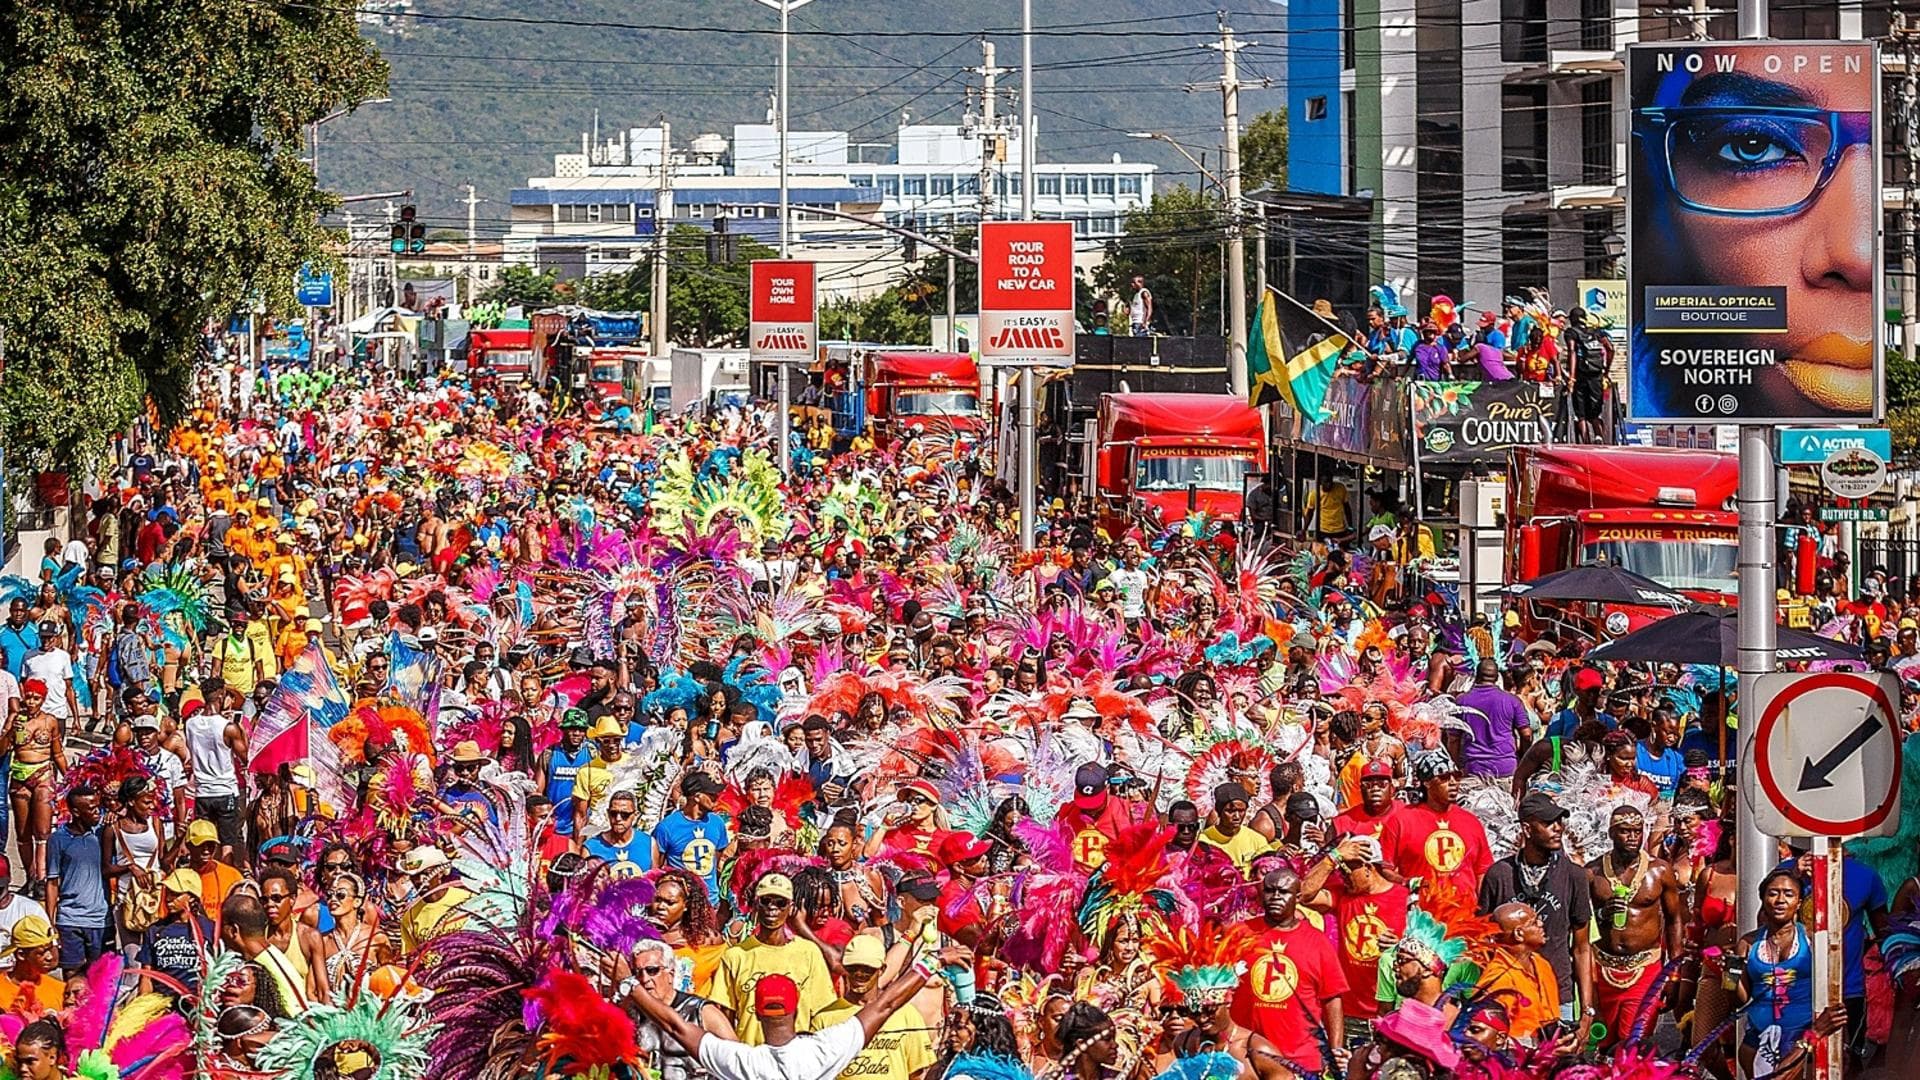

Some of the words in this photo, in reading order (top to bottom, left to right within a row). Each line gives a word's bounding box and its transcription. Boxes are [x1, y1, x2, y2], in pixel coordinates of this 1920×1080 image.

[1657, 53, 1737, 73] NOW
[1764, 54, 1861, 74] OPEN
[1008, 241, 1044, 252] YOUR
[1008, 254, 1045, 265] ROAD
[1012, 267, 1029, 277] TO
[1031, 267, 1042, 277] A
[770, 278, 795, 286] YOUR
[998, 279, 1028, 290] NEW
[1029, 279, 1056, 290] CAR
[771, 287, 794, 295] OWN
[769, 296, 795, 304] HOME
[1655, 296, 1717, 307] IMPERIAL
[1719, 296, 1776, 307] OPTICAL
[1019, 317, 1046, 326] EASY
[1048, 318, 1059, 326] AS
[1680, 311, 1748, 321] BOUTIQUE
[1660, 348, 1776, 366] SOVEREIGN
[1684, 367, 1753, 385] NORTH
[1487, 402, 1533, 420] Pure
[1822, 438, 1866, 449] ACTIVE
[1142, 448, 1190, 457] ZOUKIE
[1193, 448, 1256, 459] TRUCKING
[1822, 509, 1860, 520] RUTHVEN
[1862, 509, 1877, 520] RD.
[1598, 528, 1663, 540] ZOUKIE
[1673, 530, 1739, 543] TRUCKI
[842, 1055, 890, 1077] Babes
